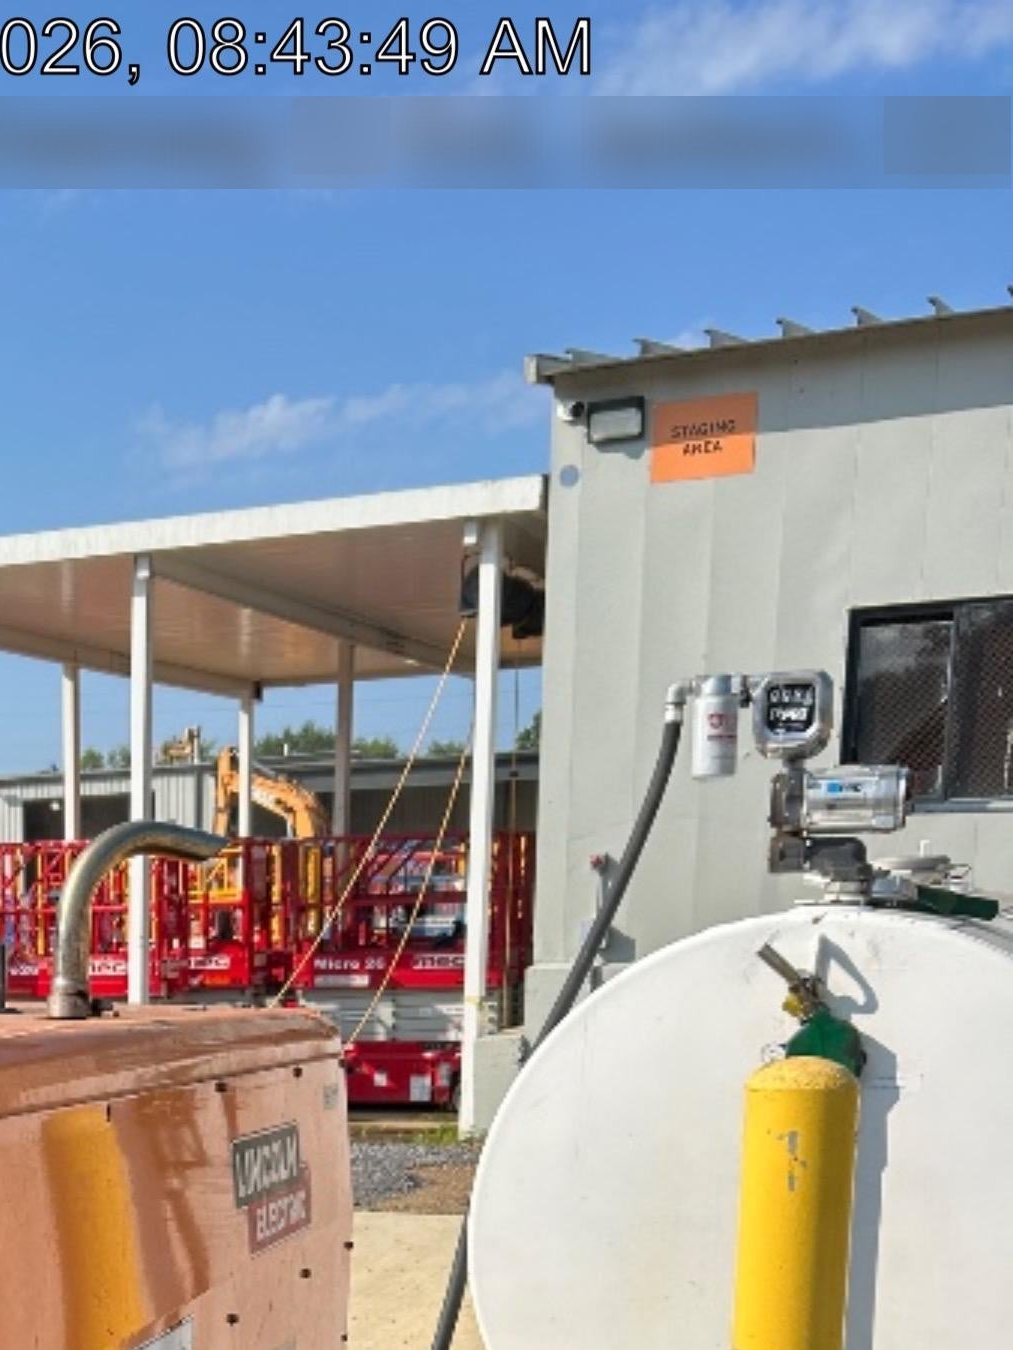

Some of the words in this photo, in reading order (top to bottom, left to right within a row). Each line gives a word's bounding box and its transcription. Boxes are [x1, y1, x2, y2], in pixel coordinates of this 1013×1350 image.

[671, 420, 735, 438] STAGING
[682, 440, 723, 456] AREA
[235, 1132, 298, 1198] LINCOLN
